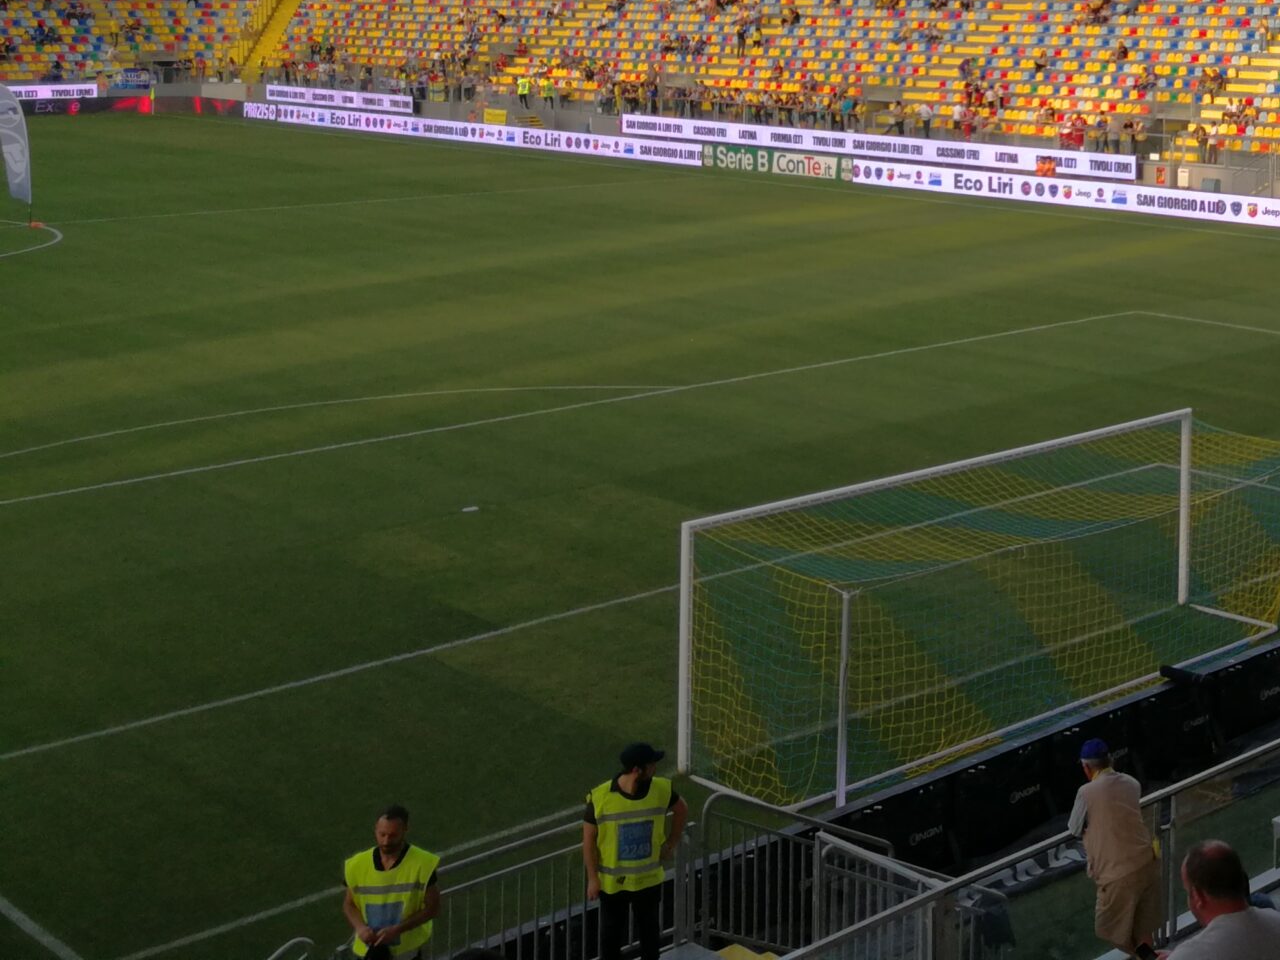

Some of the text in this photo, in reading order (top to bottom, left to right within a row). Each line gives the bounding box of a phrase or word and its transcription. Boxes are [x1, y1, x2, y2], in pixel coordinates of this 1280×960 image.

[243, 102, 269, 119] PROZIS
[330, 112, 346, 126] Eco
[348, 114, 361, 127] Liri
[523, 131, 541, 146] Eco
[545, 133, 561, 148] Liri
[640, 144, 652, 156] SAN
[653, 146, 677, 158] GIORGIO
[679, 148, 683, 159] A
[684, 148, 696, 160] LIRI
[693, 125, 716, 136] CASSINO
[739, 129, 757, 140] LATINA
[853, 139, 865, 150] SAN
[866, 141, 891, 153] GIORGIO
[936, 146, 965, 160] CASSINO
[995, 151, 1018, 163] LATINA
[1089, 159, 1113, 172] TIVOLI
[717, 145, 753, 170] Serie
[758, 150, 769, 172] B
[777, 154, 833, 177] ConTe.it
[897, 170, 911, 180] Jeep
[954, 173, 983, 192] Eco
[988, 176, 1013, 195] Liri
[1075, 189, 1091, 199] Jeep
[1137, 193, 1156, 207] SAN
[1158, 195, 1197, 212] GIORGIO
[1199, 200, 1206, 213] A
[1262, 206, 1280, 218] Jeep
